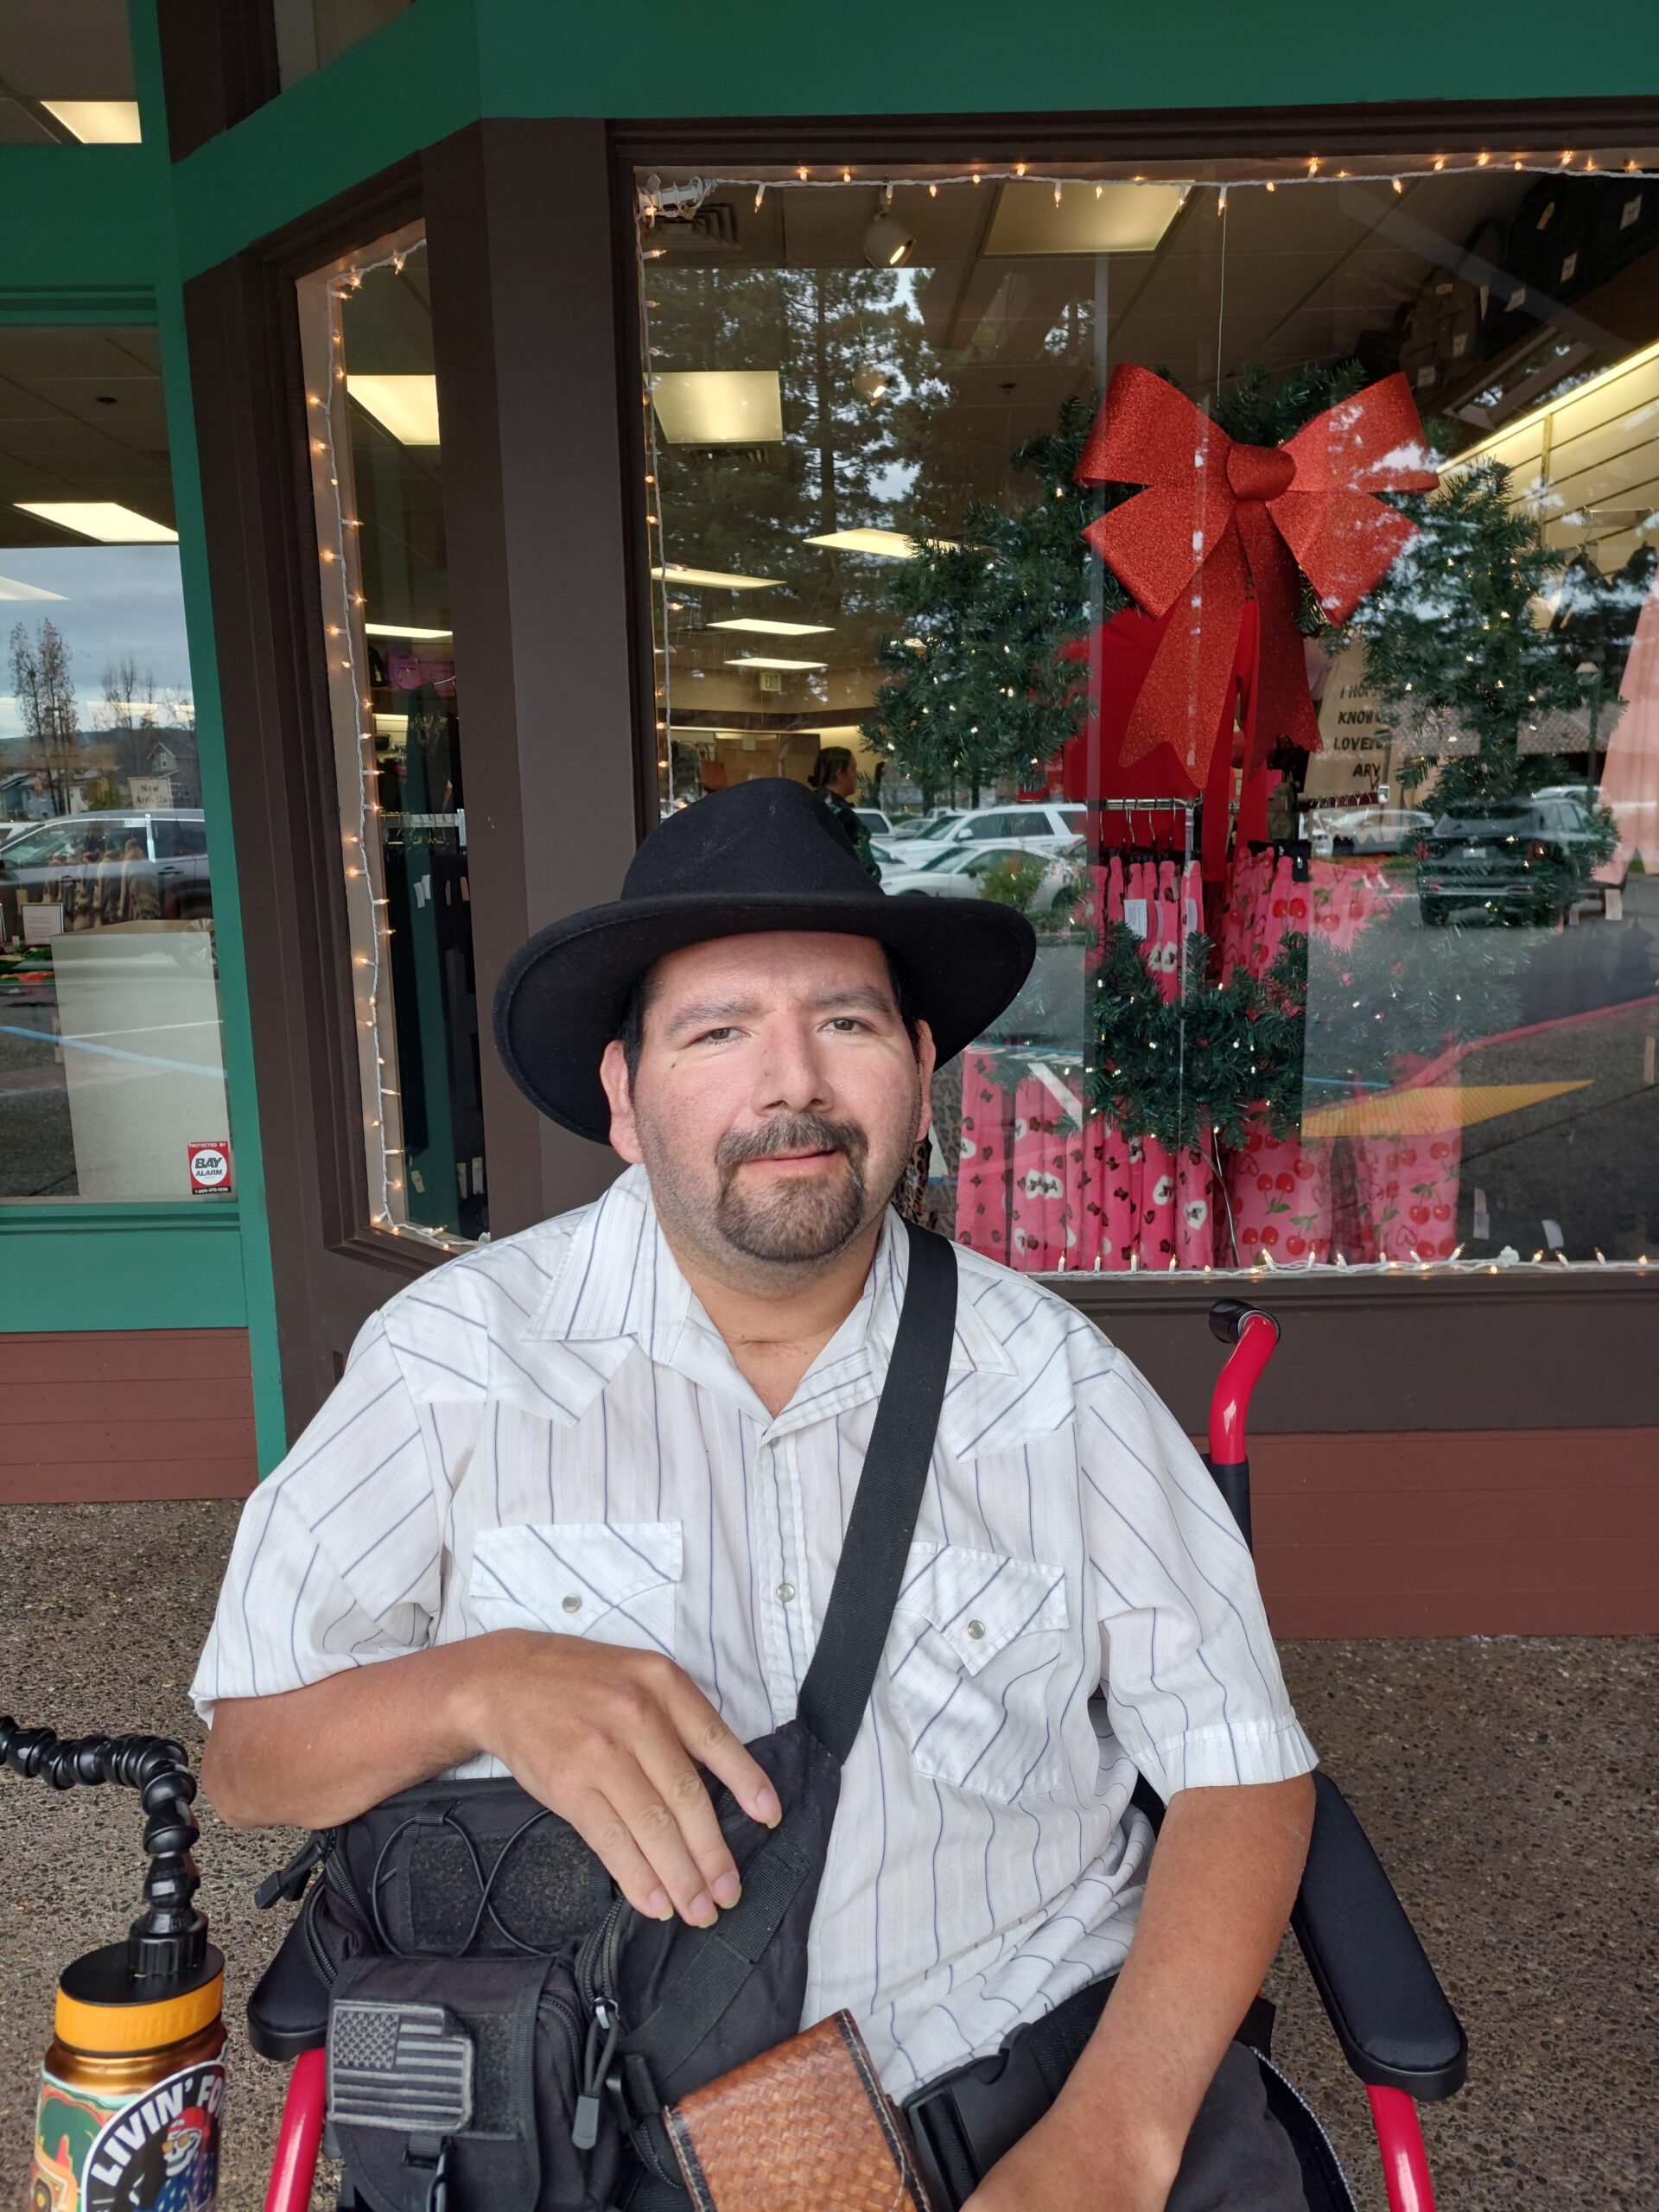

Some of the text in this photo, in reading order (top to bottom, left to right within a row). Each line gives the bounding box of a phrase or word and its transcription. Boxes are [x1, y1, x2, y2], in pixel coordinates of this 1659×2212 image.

[195, 1157, 223, 1168] BAY
[91, 2075, 224, 2187] LIVIN' FO
